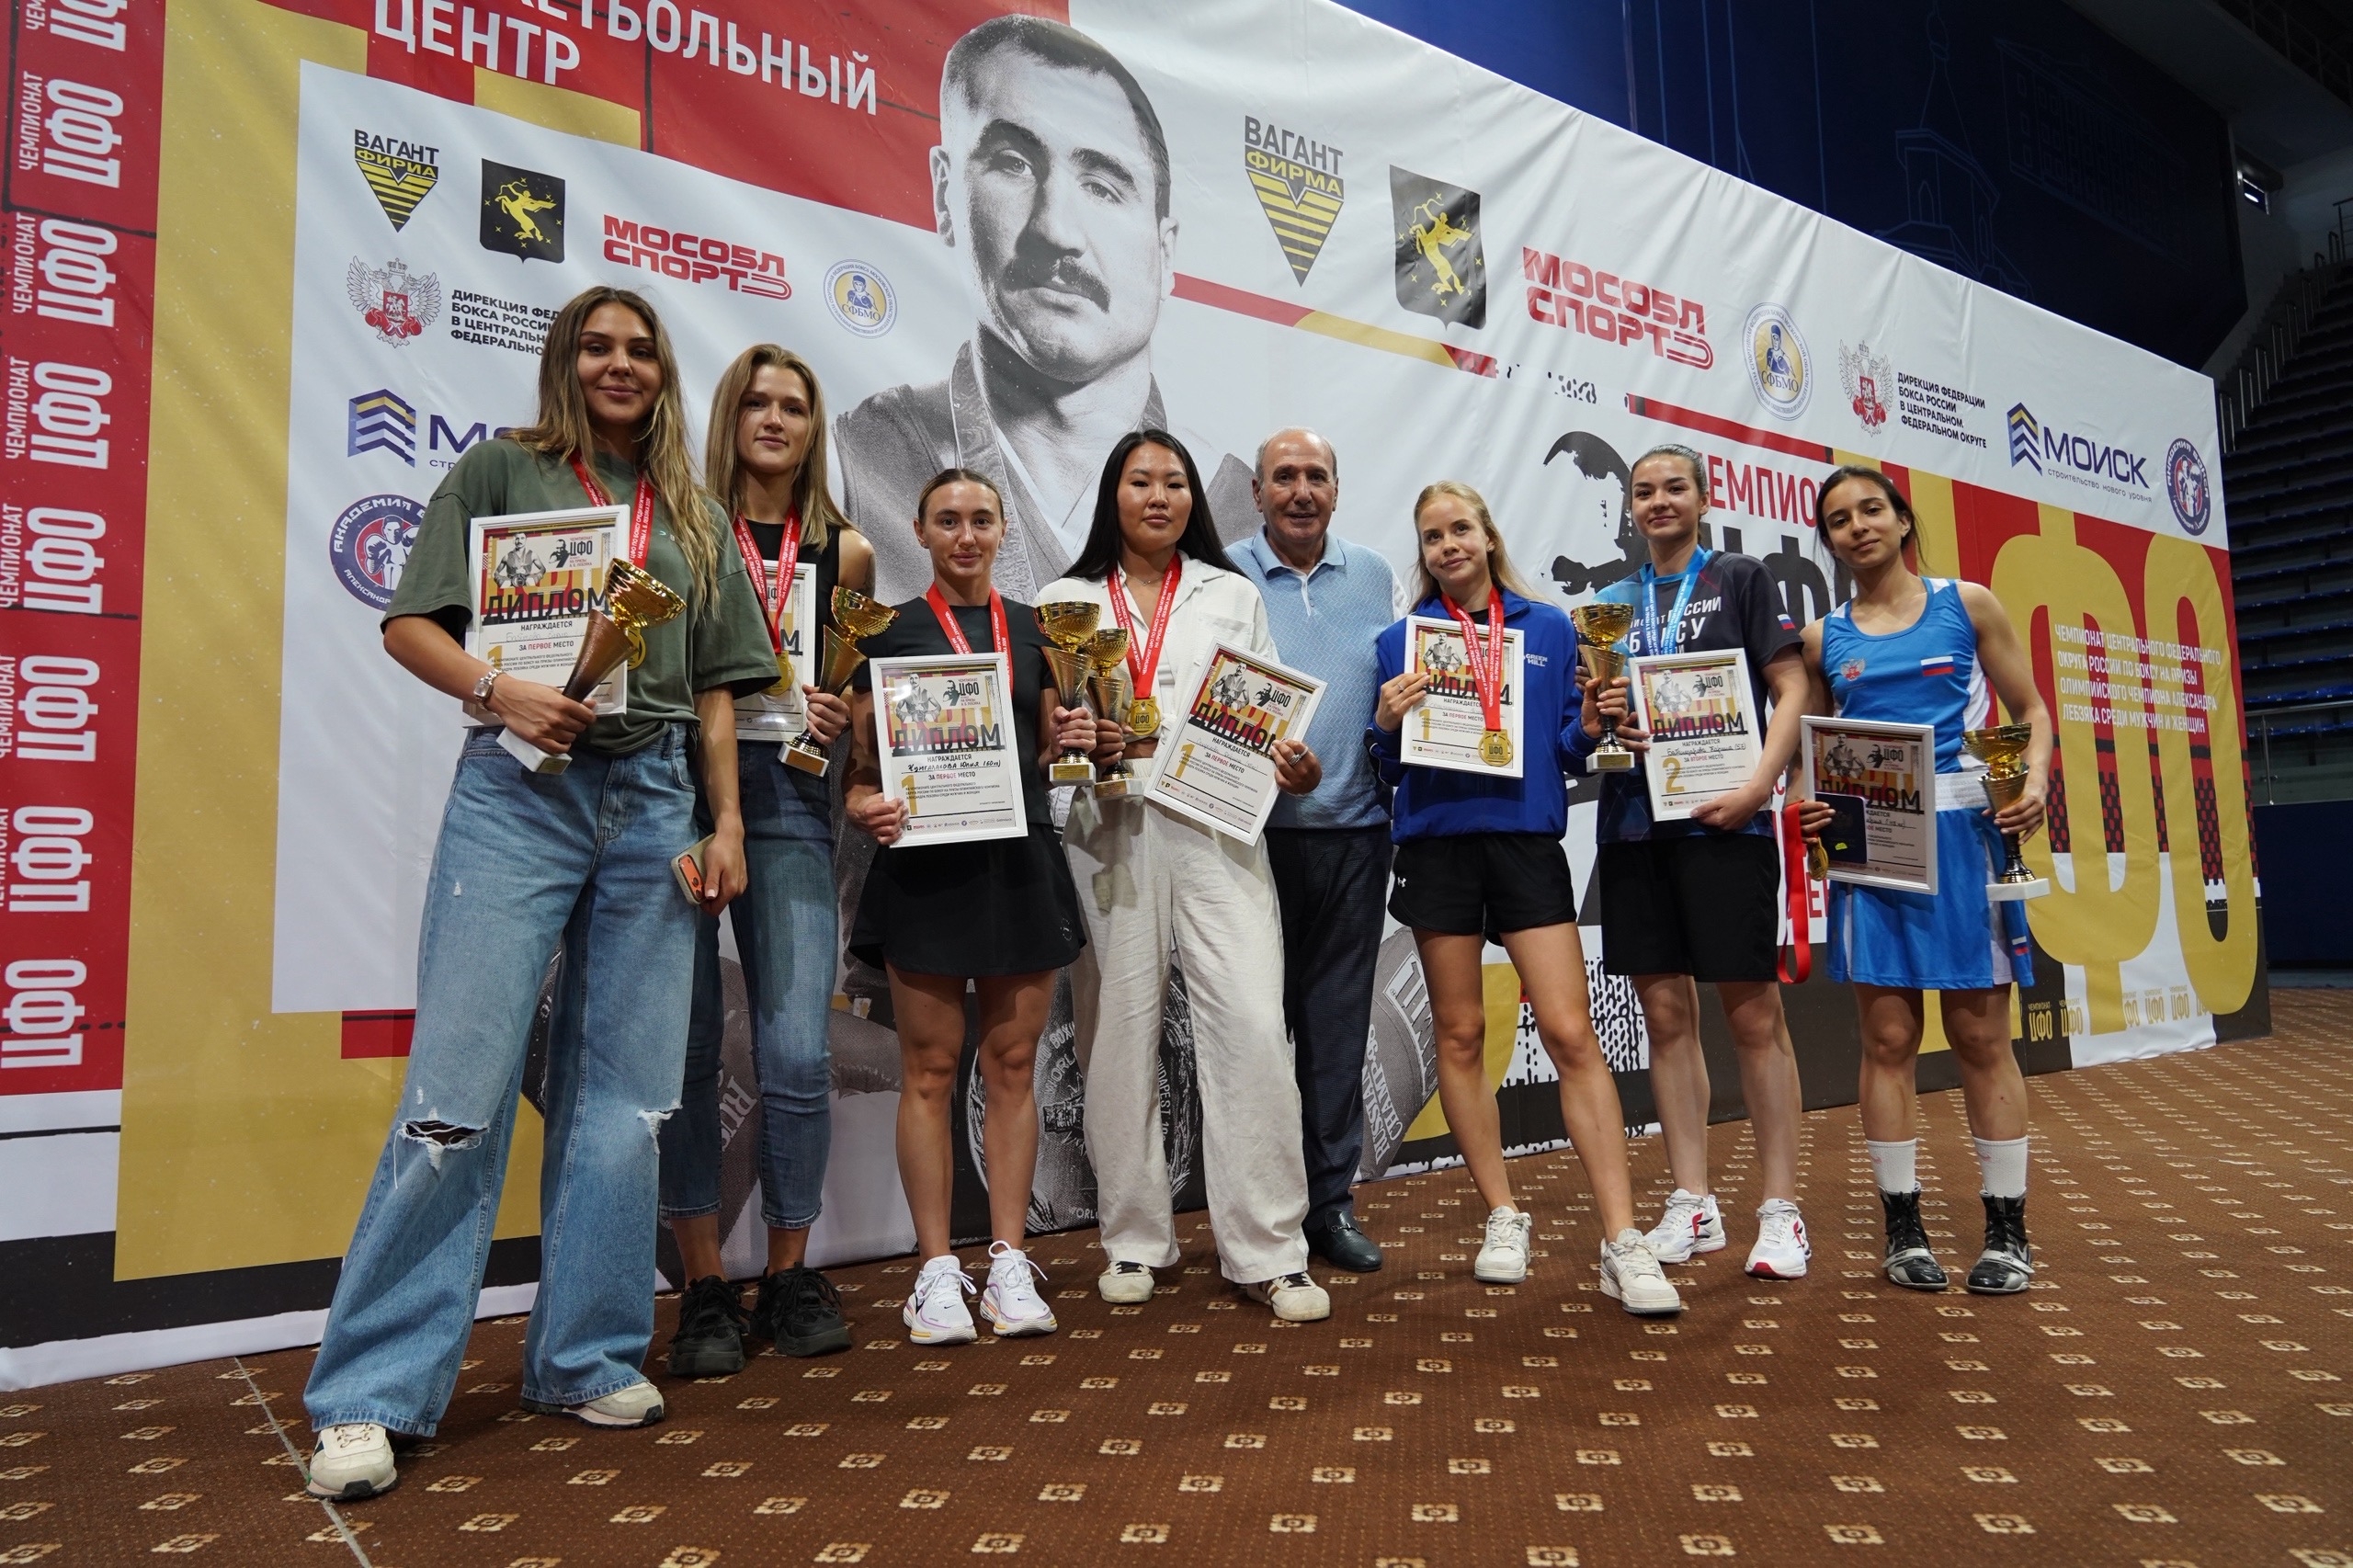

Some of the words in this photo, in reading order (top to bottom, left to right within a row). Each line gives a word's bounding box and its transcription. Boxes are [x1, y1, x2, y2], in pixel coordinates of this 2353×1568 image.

[373, 0, 581, 85] ЦЕНТР
[19, 71, 42, 171] ЧЕМПИОНАТ
[43, 79, 123, 188] ЦФО
[355, 129, 439, 165] ВАГАНТ
[1245, 115, 1343, 176] ВАГАНТ
[1246, 147, 1342, 199] ФИРМА
[13, 212, 36, 313] ЧЕМПИОНАТ
[604, 214, 785, 278] МОСОБЛ
[38, 220, 118, 327] ЦФО
[604, 239, 749, 291] СПОРТ
[452, 290, 528, 314] ДИРЕКЦИЯ
[531, 307, 562, 322] ФЕД
[1523, 246, 1705, 335] МОСОБЛ
[452, 302, 499, 322] БОКСА
[842, 303, 881, 322] СФБМО
[1527, 286, 1671, 358] СПОРТ
[451, 330, 543, 356] ФЕДЕРАЛЬНО
[452, 316, 461, 326] В
[464, 317, 546, 345] ЦЕНТРАЛЬН
[1761, 369, 1799, 393] СФБМО
[1898, 372, 1939, 393] ДИРЕКЦИЯ
[1941, 386, 1985, 409] ФЕДЕРАЦИИ
[6, 357, 30, 460] ЧЕМПИОНАТ
[30, 362, 112, 470] ЦФО
[1899, 386, 1925, 403] БОКСА
[1927, 395, 1956, 413] РОССИИ
[1900, 401, 1905, 410] В
[1907, 403, 1963, 428] ЦЕНТРАЛЬНОМ
[1901, 415, 1959, 440] ФЕДЕРАЛЬНОМ
[1961, 433, 1986, 449] ОКРУГЕ
[2043, 426, 2150, 489] МОИСК
[1707, 453, 1817, 528] ЕМПИО
[2048, 469, 2099, 489] строительство
[2102, 485, 2126, 496] нового
[2129, 492, 2152, 503] уровня
[1, 503, 23, 608] ЧЕМПИОНАТ
[23, 506, 106, 614] ЦФО
[570, 540, 593, 556] ЦФО
[344, 569, 392, 605] АЛЕКСАНДР
[483, 587, 610, 625] ДИПЛОМ
[520, 620, 573, 631] НАГРАЖДАЕТСЯ
[528, 642, 551, 651] ПЕРВОЕ
[1526, 653, 1548, 662] GREEN
[2054, 624, 2105, 648] ЧЕМПИОНАТ
[2106, 633, 2165, 656] ЦЕНТРАЛЬНОГО
[2166, 642, 2221, 665] ФЕДЕРАЛЬНОГО
[1528, 658, 1545, 667] HILL
[2058, 651, 2088, 669] ОКРУГА
[2088, 655, 2121, 675] РОССИИ
[2123, 660, 2133, 676] ПО
[2136, 663, 2158, 680] БОКСУ
[2160, 666, 2171, 682] НА
[2171, 667, 2198, 686] ПРИЗЫ
[959, 682, 979, 697] ЦФО
[1272, 689, 1291, 708] ЦФО
[1704, 676, 1723, 688] ЦФО
[2060, 677, 2127, 701] ОЛИМПИЙСКОГО
[2128, 687, 2170, 705] ЧЕМПИОНА
[2172, 691, 2217, 712] АЛЕКСАНДРА
[17, 654, 99, 762] ЦФО
[2063, 703, 2100, 724] ЛЕБЗЯКА
[2101, 707, 2128, 728] СРЕДИ
[2130, 711, 2164, 730] МУЖЧИН
[2165, 715, 2170, 730] И
[2172, 715, 2205, 734] ЖЕНЩИН
[892, 723, 1006, 756] ДИПЛОМ
[1653, 711, 1748, 743] ДИПЛОМ
[1682, 738, 1720, 746] НАГРАЖДАЕТСЯ
[927, 754, 972, 763] НАГРАЖДАЕТСЯ
[1212, 736, 1251, 758] НАГРАЖДАЕТСЯ
[1884, 748, 1904, 762] ЦФО
[1211, 755, 1229, 766] ПЕРВОЕ
[1229, 763, 1245, 774] МЕСТО
[1662, 757, 1685, 793] 2
[9, 805, 93, 912] ЦФО
[1, 960, 86, 1068] ЦФО
[2060, 1006, 2084, 1037] ЦФО
[2124, 1000, 2140, 1027] ФО
[2145, 996, 2165, 1023] ЦФО
[2170, 994, 2189, 1020] ЦФО
[2029, 1009, 2052, 1041] ЦФО
[1044, 1047, 1077, 1094] WORL
[1362, 1062, 1390, 1165] RUSSIAN
